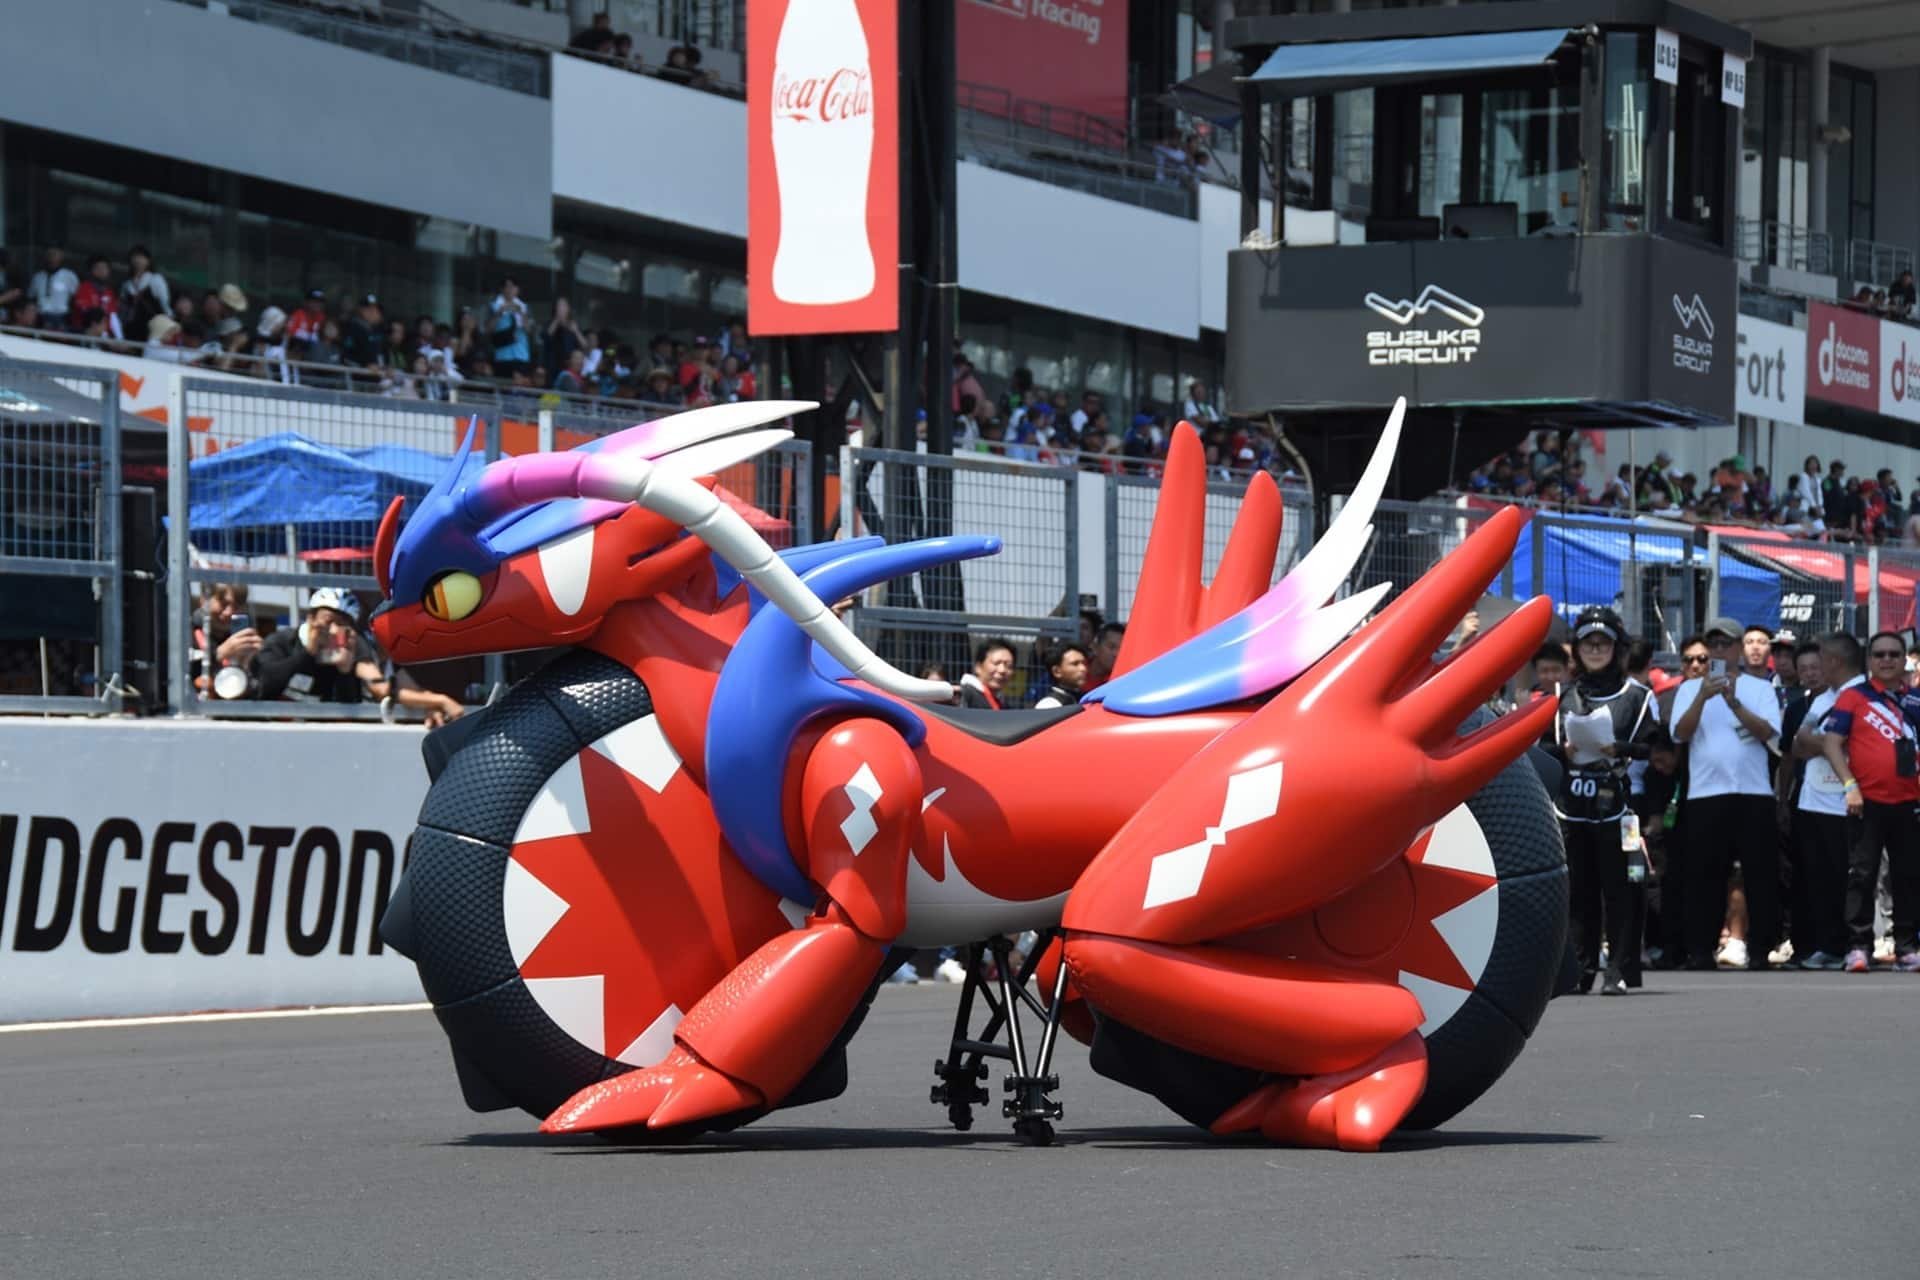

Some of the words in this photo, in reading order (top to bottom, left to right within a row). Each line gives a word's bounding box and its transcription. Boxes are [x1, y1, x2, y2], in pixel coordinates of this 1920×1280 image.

[1032, 0, 1101, 44] Racing
[1366, 328, 1481, 347] SUZUKA
[1672, 333, 1713, 357] SUZUKA
[1368, 346, 1478, 365] CIRCUIT
[1672, 351, 1712, 374] CIRCUIT
[1835, 336, 1869, 366] docomo
[1835, 360, 1870, 389] business
[1570, 778, 1597, 797] 00
